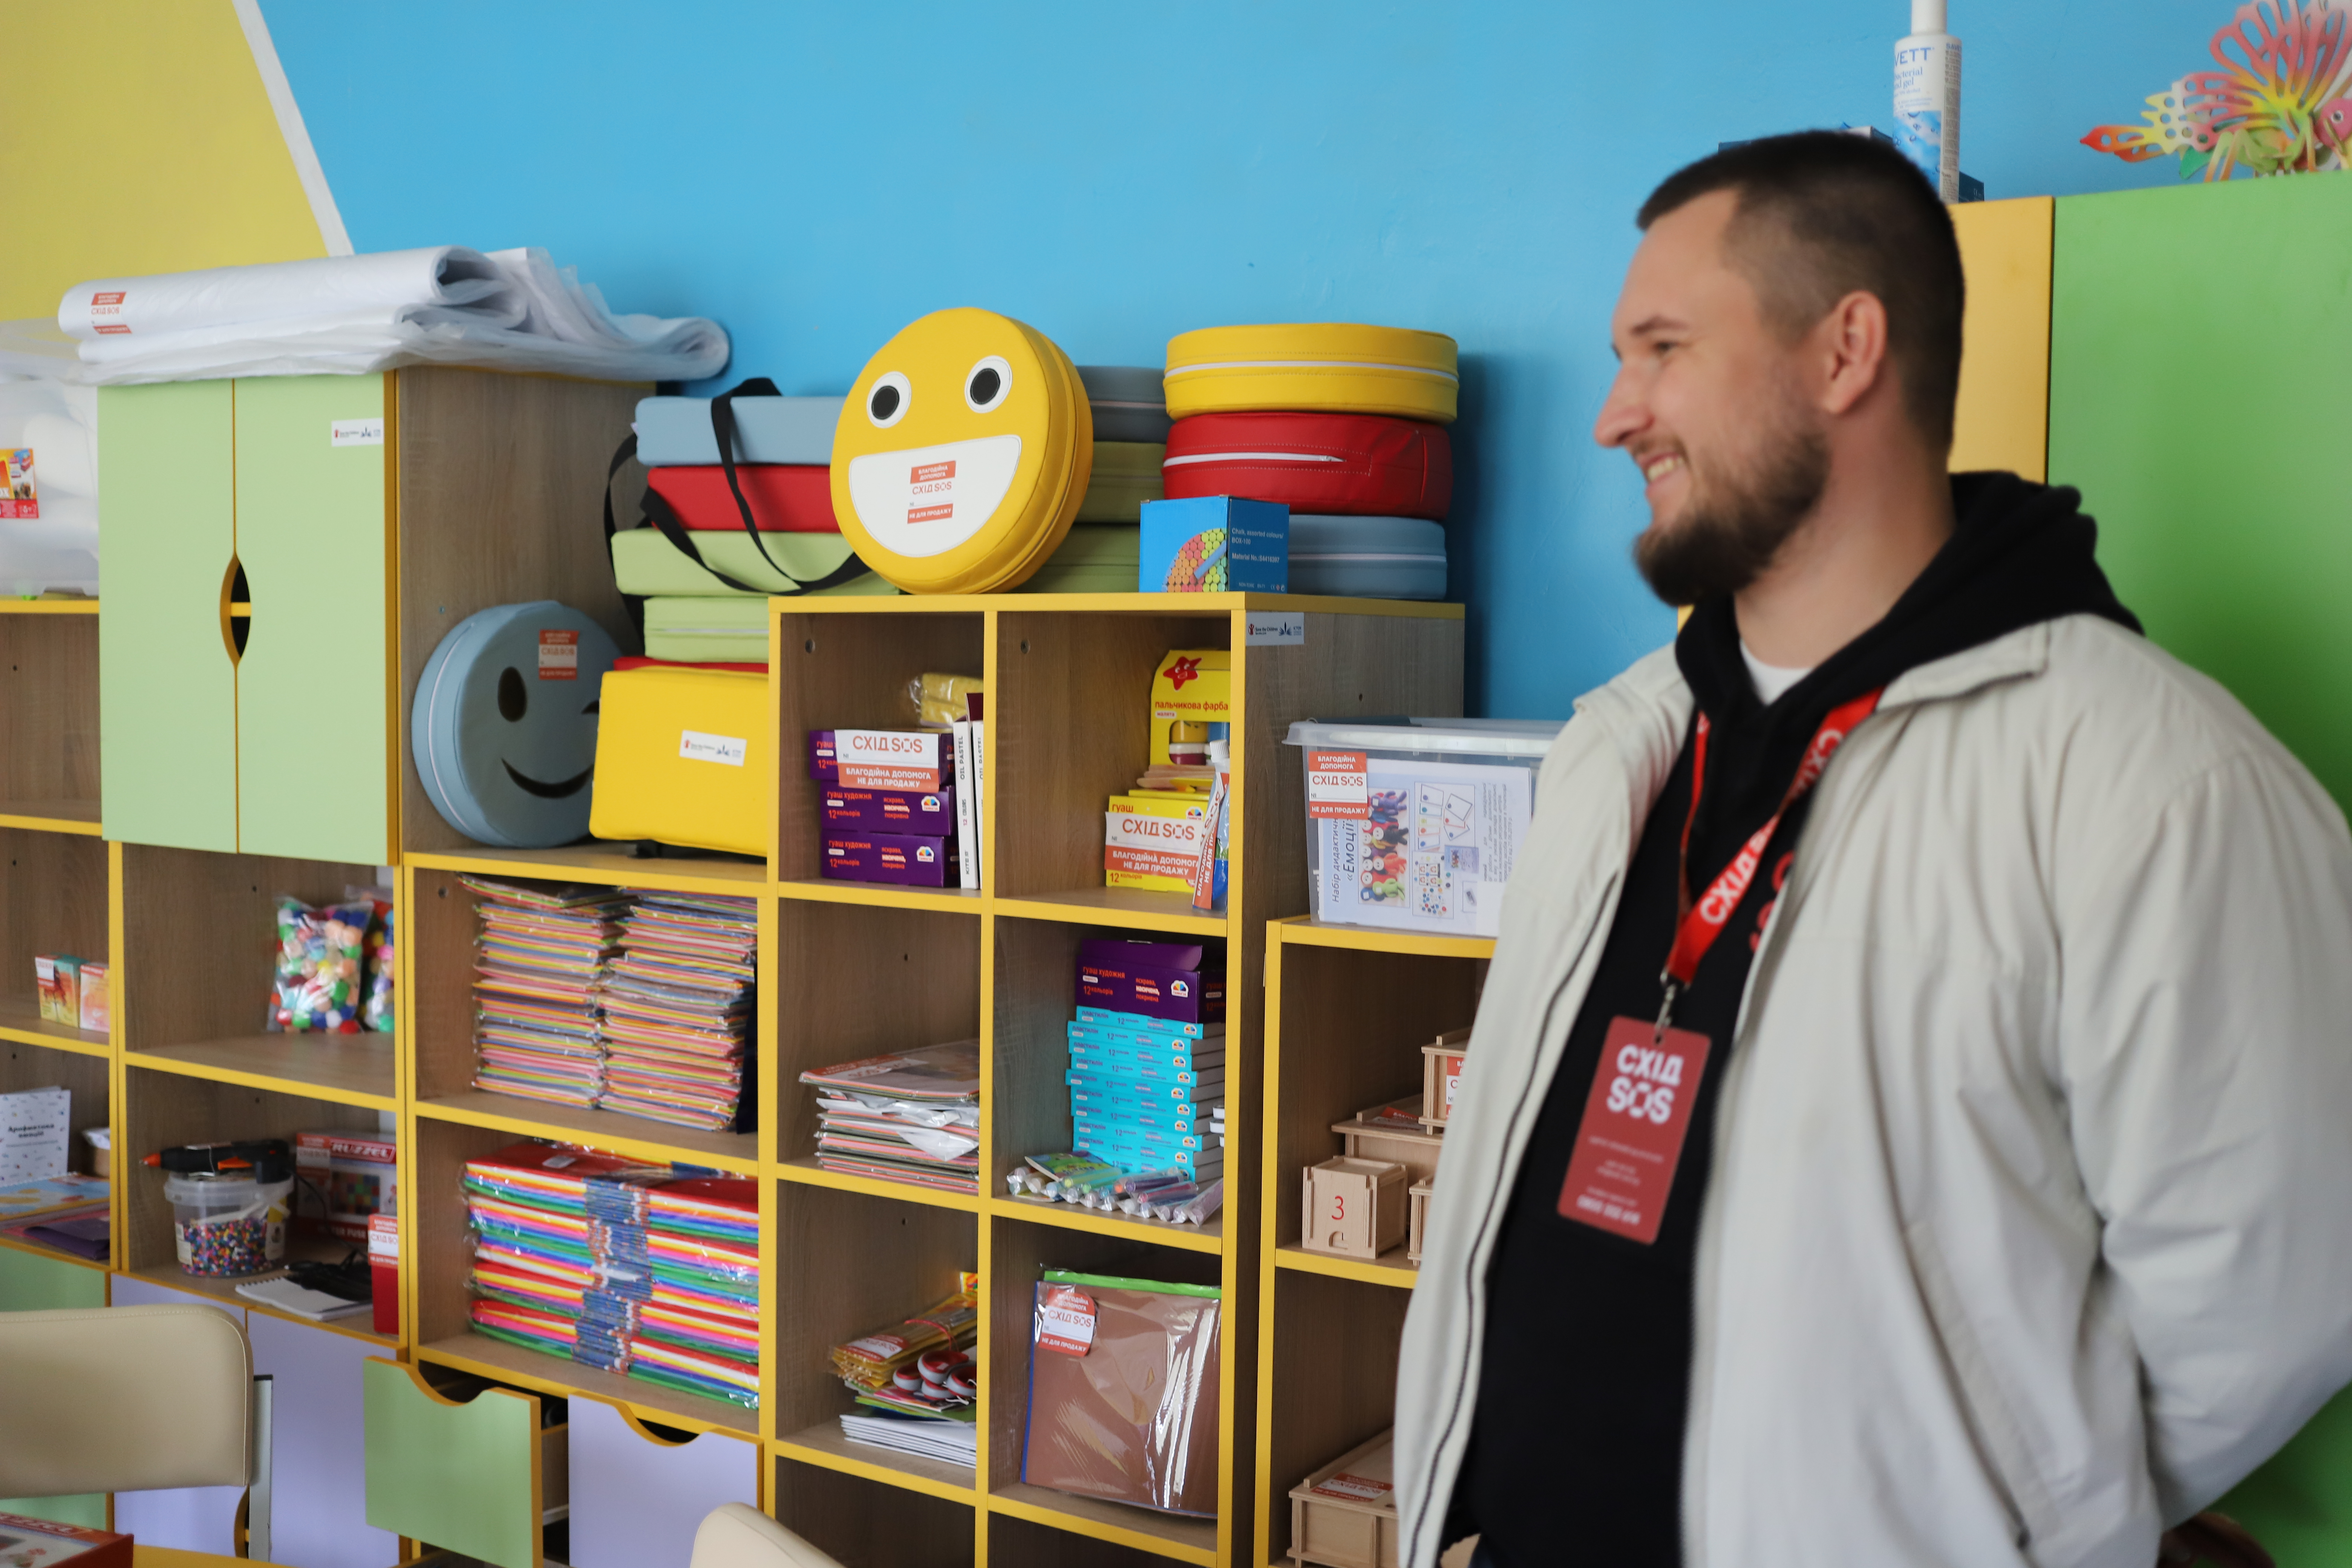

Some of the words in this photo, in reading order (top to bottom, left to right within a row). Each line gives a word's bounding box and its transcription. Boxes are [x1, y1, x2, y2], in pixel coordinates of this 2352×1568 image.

[1903, 77, 1914, 89] gel
[918, 465, 948, 475] БЛАГОДІЙНА
[920, 472, 946, 481] ДОПОМОГА
[913, 484, 933, 495] СХІД
[934, 481, 952, 492] SOS
[1232, 537, 1251, 545] BOX-100
[1203, 701, 1228, 712] фарба
[853, 735, 889, 751] СХІД
[891, 738, 923, 753] SOS
[818, 760, 827, 769] 12
[1318, 755, 1356, 763] БЛАГОДІЙНА
[846, 767, 890, 778] БЛАГОДІЙНА
[892, 770, 931, 780] ДОПОМОГА
[884, 779, 920, 788] ПРОДАЖУ
[1312, 775, 1339, 786] СХІД
[1341, 776, 1363, 787] SOS
[1112, 804, 1133, 813] гуаш
[828, 810, 837, 819] 12
[1122, 819, 1159, 836] СХІД
[1162, 823, 1194, 840] SOS
[1113, 850, 1158, 862] БЛАГОДІЙНА
[830, 859, 838, 868] 12
[1134, 862, 1148, 871] ДЛЯ
[1151, 864, 1189, 875] ПРОДАЖУ
[1110, 873, 1119, 883] 12
[1204, 868, 1210, 883] НЕ
[1331, 873, 1341, 902] Набір
[1699, 846, 1759, 925] СХІД
[1099, 969, 1125, 978] художня
[1083, 985, 1091, 995] 12
[1616, 1044, 1684, 1087] СХІД
[1606, 1076, 1675, 1124] SOS
[1331, 1195, 1344, 1220] 3
[1058, 1300, 1087, 1311] ДОПОМОГА
[1049, 1310, 1072, 1323] СХІД
[1073, 1315, 1092, 1328] SOS
[1060, 1341, 1087, 1352] ПРОДАЖУ
